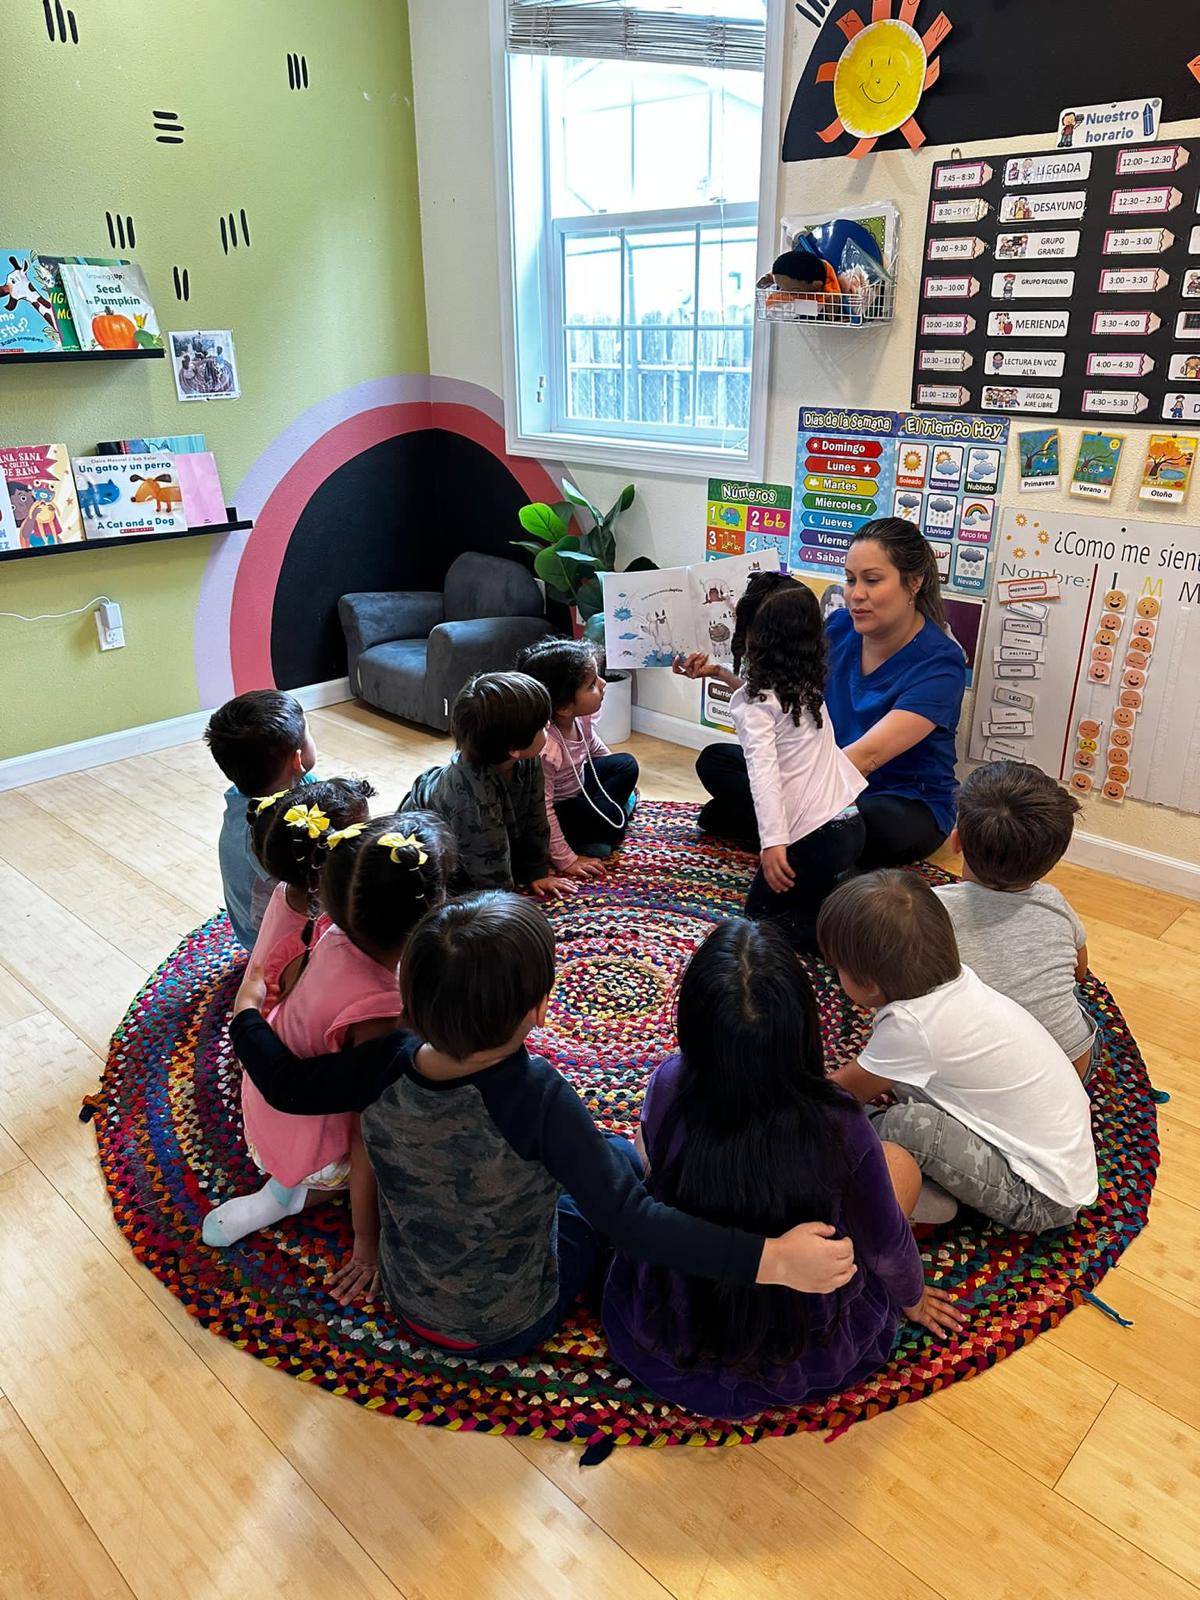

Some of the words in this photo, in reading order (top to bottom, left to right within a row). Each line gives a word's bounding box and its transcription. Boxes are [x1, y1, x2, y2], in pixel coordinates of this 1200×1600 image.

[1085, 110, 1139, 125] Nuestro
[1085, 127, 1134, 143] horario
[1123, 158, 1143, 166] 12:00
[1150, 155, 1171, 164] 12:30
[961, 173, 975, 181] 8:30
[1119, 197, 1139, 205] 12:30
[1146, 195, 1162, 203] 2:30
[1033, 200, 1083, 213] DESAYUNO
[1041, 237, 1065, 245] GRUPO
[1136, 237, 1153, 245] 3:00
[954, 244, 967, 252] 9:30
[96, 284, 122, 293] Seed
[94, 296, 141, 307] Pumpkin
[1015, 319, 1066, 329] MERIENDA
[1004, 358, 1032, 366] LECTURA
[1043, 359, 1057, 367] VOZ
[1118, 361, 1134, 369] 4:30
[1037, 401, 1053, 409] LIBRE
[826, 413, 838, 426] de
[839, 413, 849, 426] la
[851, 414, 891, 431] Semana
[907, 418, 920, 434] El
[923, 420, 970, 436] Tiempo
[974, 422, 1002, 439] Hoy
[821, 440, 866, 454] Domingo
[16, 466, 41, 477] RANA
[79, 465, 93, 473] Un
[96, 464, 119, 474] gato
[145, 462, 171, 470] perro
[827, 460, 856, 472] Lunes
[823, 478, 857, 491] Martes
[967, 483, 994, 492] Nublado
[1024, 480, 1056, 488] Primavera
[1079, 484, 1102, 494] Verano
[722, 485, 776, 502] Números
[1150, 489, 1173, 498] Otoño
[815, 496, 862, 512] Miércoles
[710, 506, 716, 519] 1
[126, 518, 144, 527] and
[155, 517, 175, 526] Dog
[751, 511, 760, 526] 2
[820, 516, 853, 529] Jueves
[926, 526, 951, 536] Lluvioso
[961, 532, 976, 540] Arco
[709, 530, 716, 545] 3
[749, 538, 758, 551] 4
[1054, 531, 1115, 560] ¿Como
[1121, 544, 1150, 565] me
[816, 550, 846, 564] Sábad
[1001, 562, 1091, 589] Nombre:
[958, 577, 981, 587] Nevado
[1141, 576, 1163, 598] M
[1178, 581, 1200, 604] M
[1008, 694, 1022, 702] LEO
